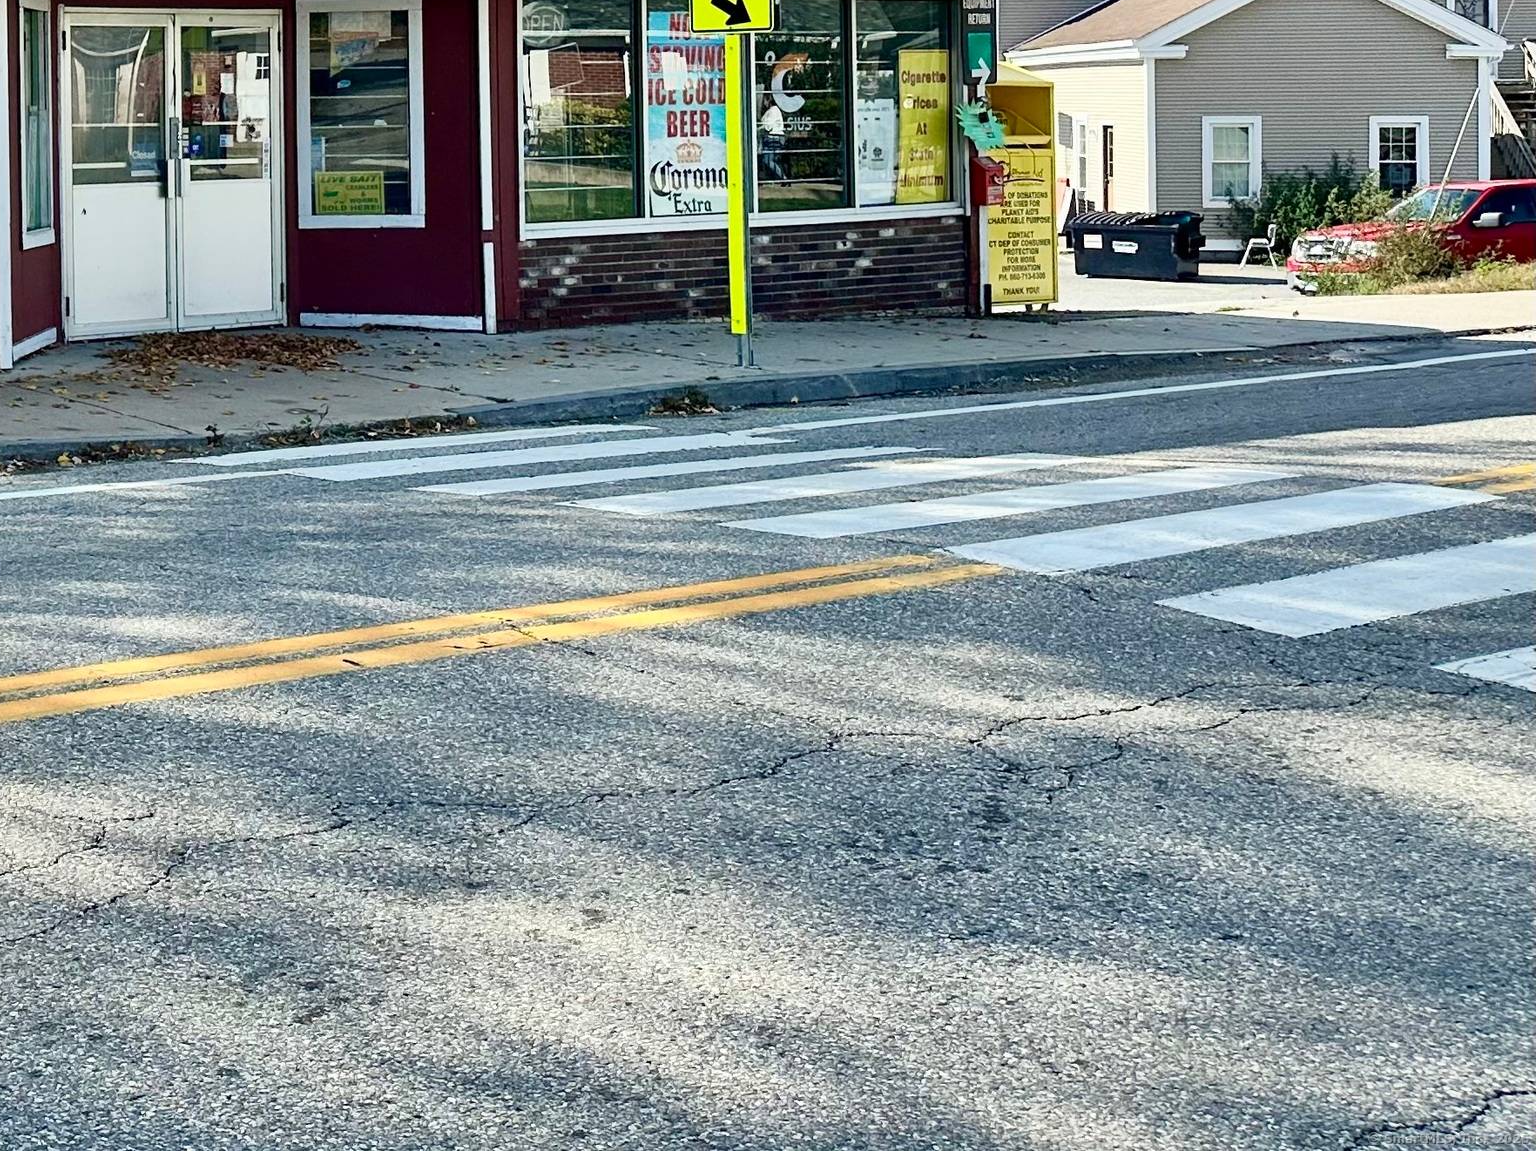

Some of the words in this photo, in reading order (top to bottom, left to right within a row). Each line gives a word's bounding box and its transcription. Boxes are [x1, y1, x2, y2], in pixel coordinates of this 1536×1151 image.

[901, 70, 946, 86] Cigarette
[904, 95, 938, 109] rices
[667, 110, 710, 137] BEER
[916, 123, 928, 135] At
[650, 160, 729, 197] Corona
[673, 193, 712, 213] Extra
